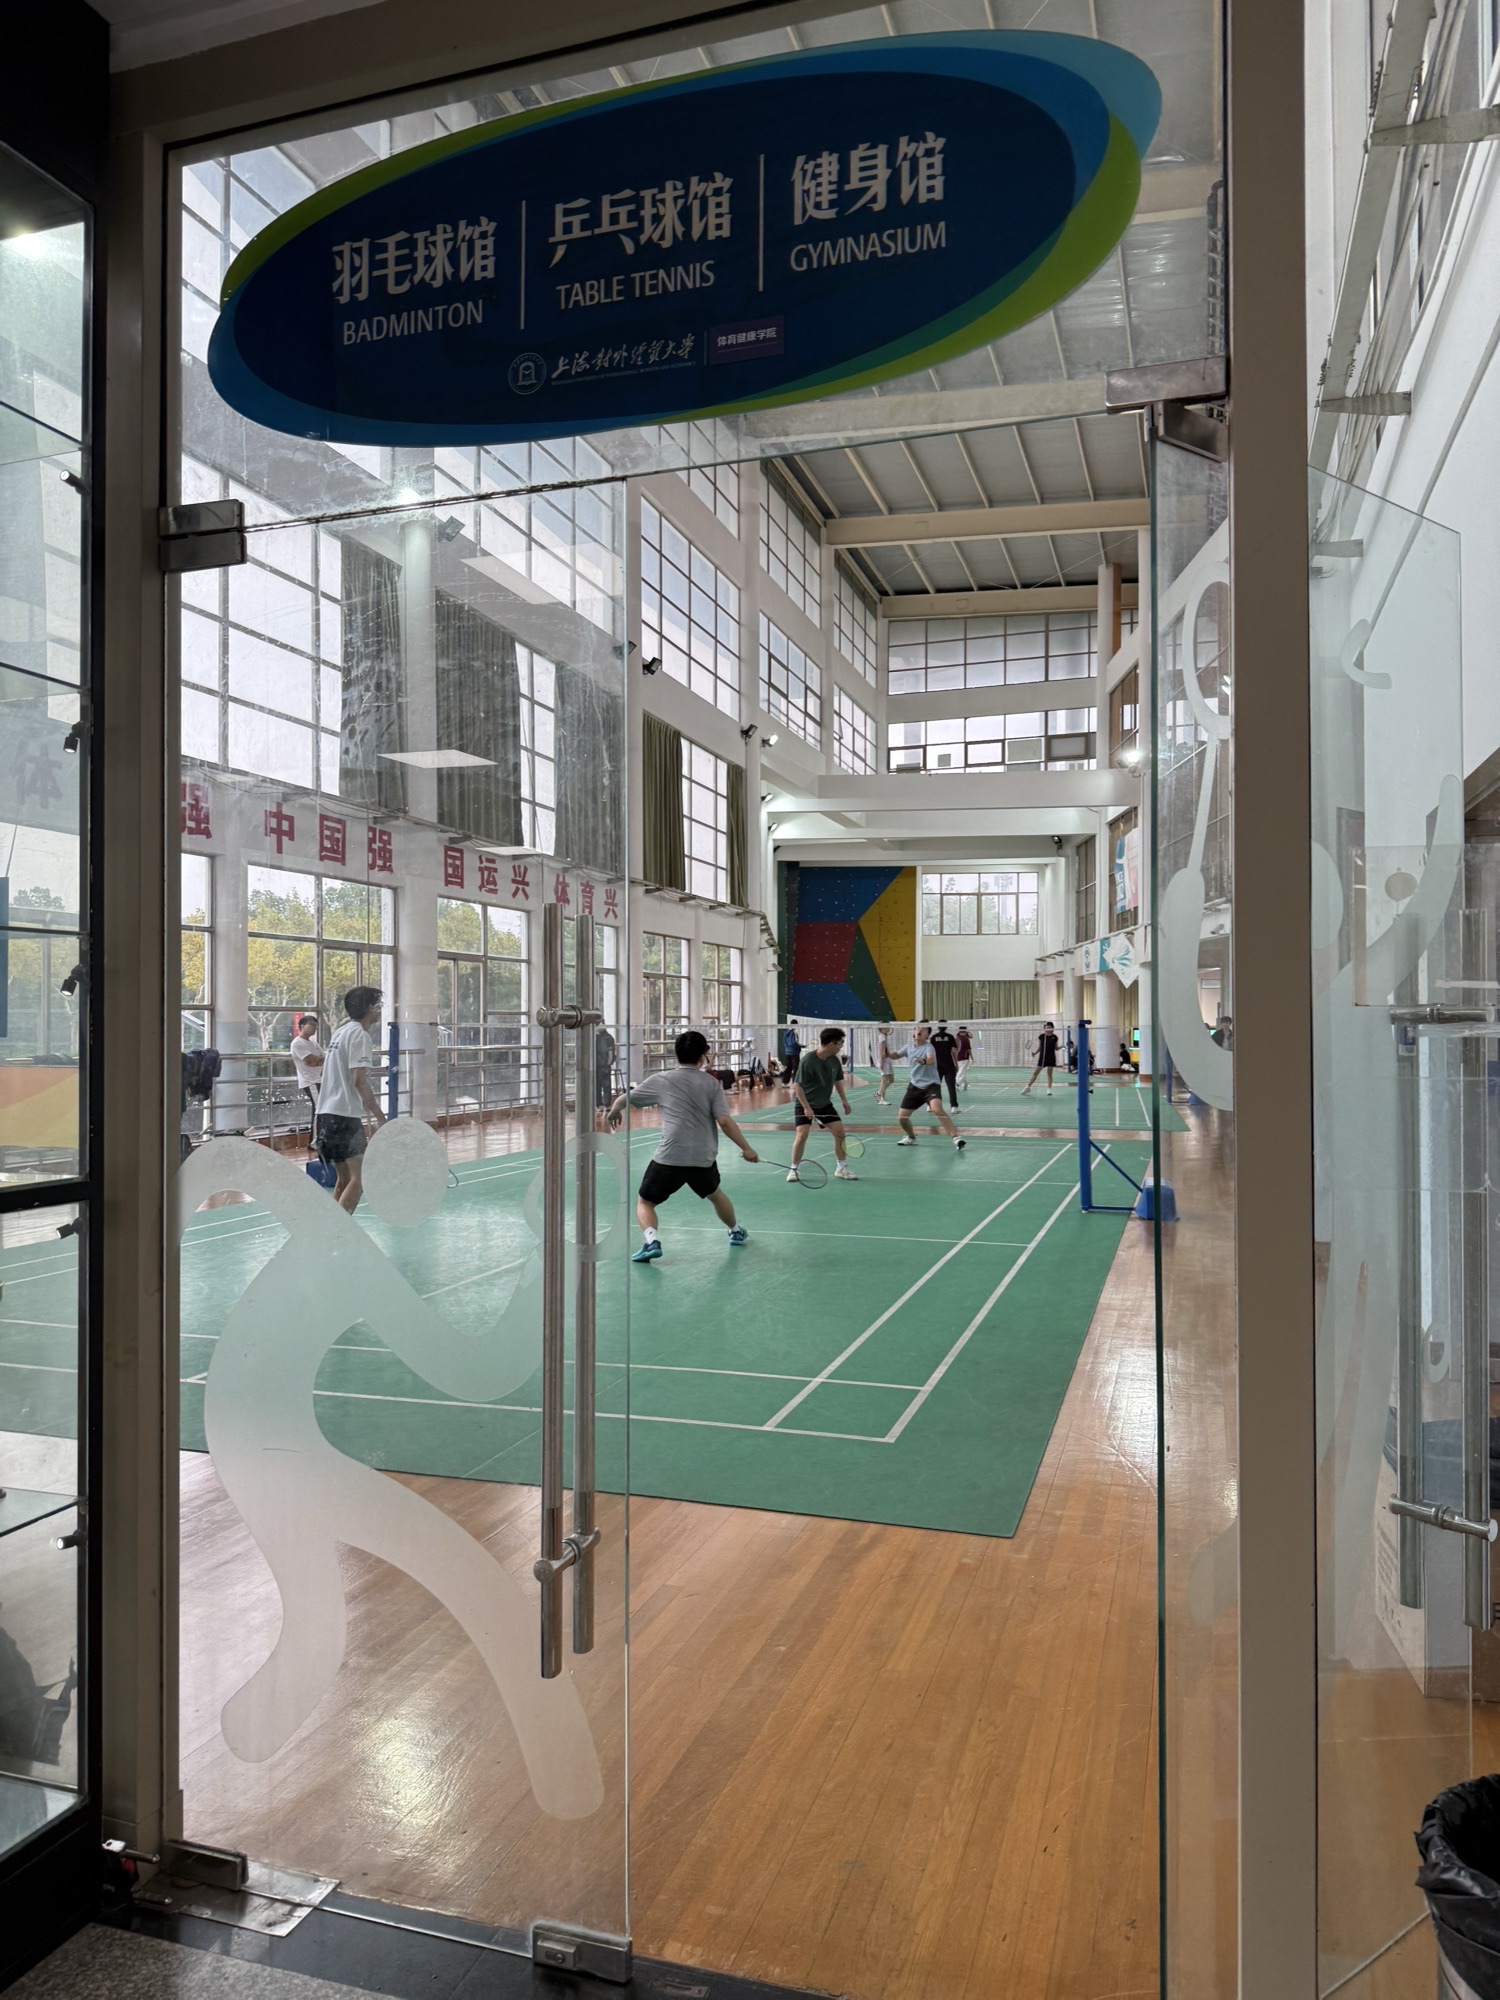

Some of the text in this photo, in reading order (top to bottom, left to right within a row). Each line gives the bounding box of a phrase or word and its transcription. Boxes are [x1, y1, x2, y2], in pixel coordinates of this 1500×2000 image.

[548, 171, 734, 269] 乒乓球馆
[790, 130, 947, 226] 健身馆
[331, 215, 498, 305] 羽毛球馆
[555, 260, 715, 310] TABLE TENNIS
[790, 221, 947, 272] GYMNASIUM
[343, 299, 484, 346] BADMINTON
[264, 802, 394, 875] 中国强
[444, 845, 530, 901] 国运兴
[553, 873, 618, 919] 体育兴
